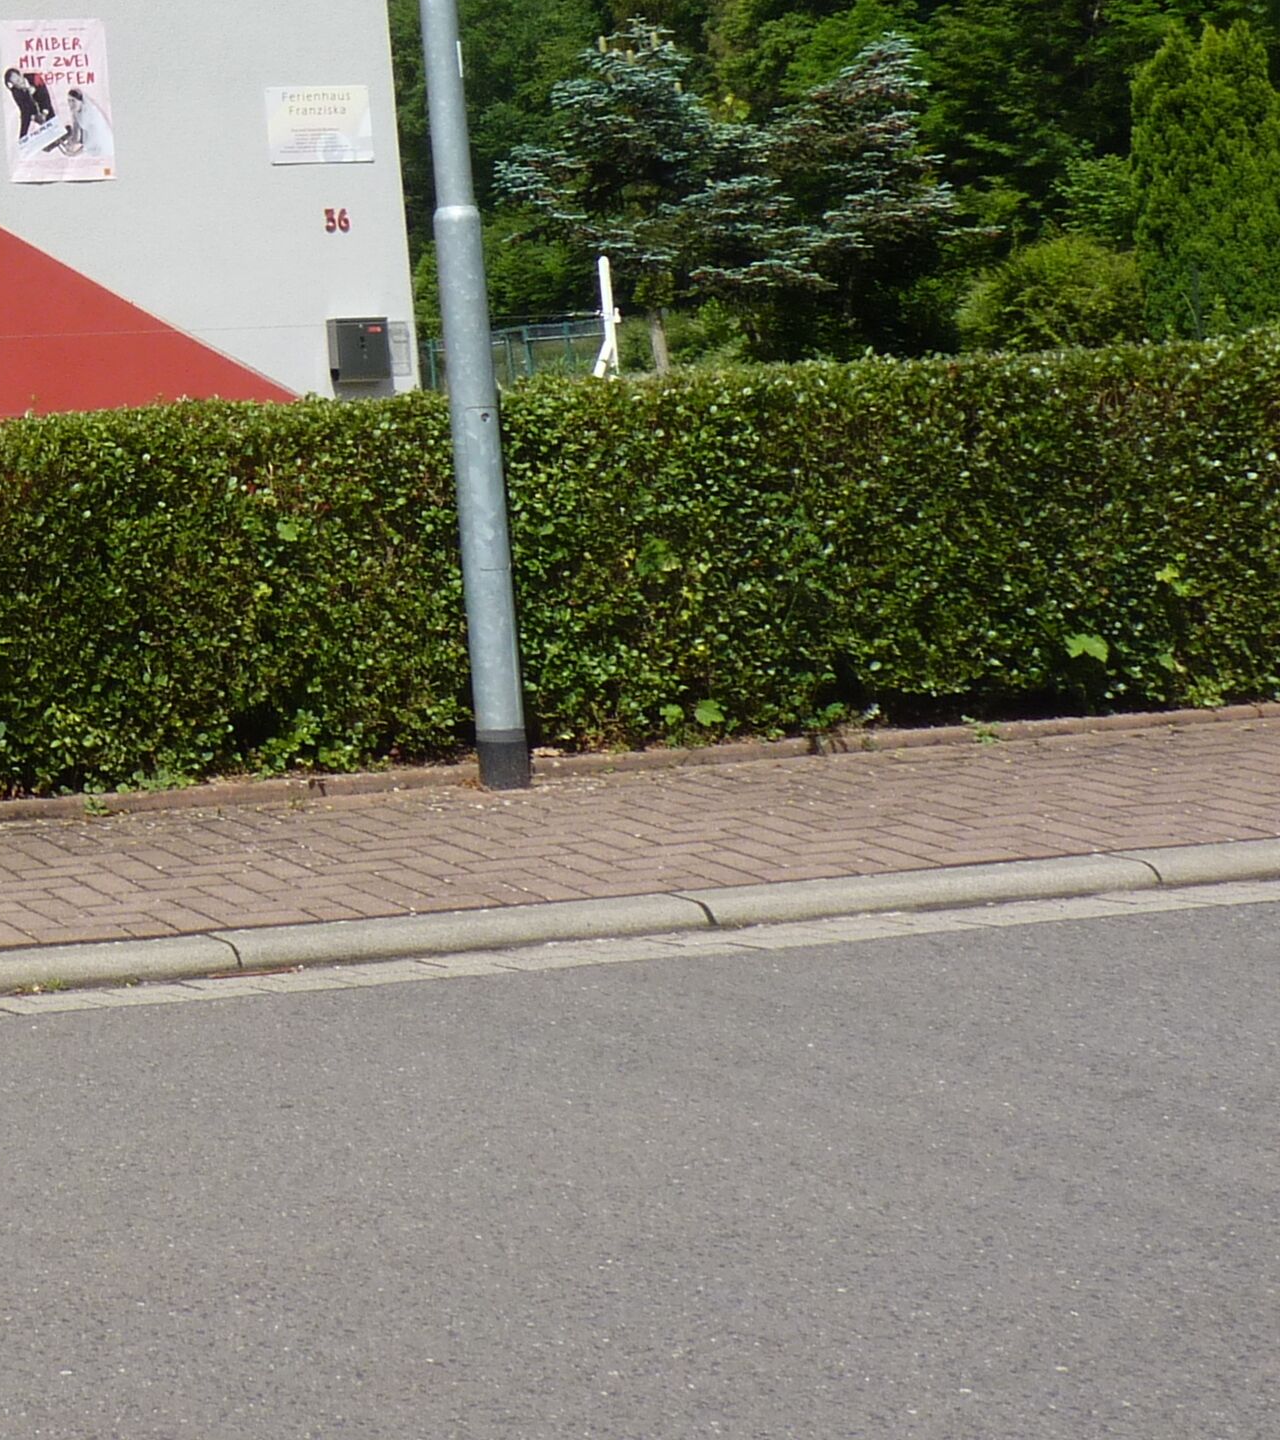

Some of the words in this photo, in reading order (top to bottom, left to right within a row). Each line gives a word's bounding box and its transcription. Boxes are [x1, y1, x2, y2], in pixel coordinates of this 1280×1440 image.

[19, 55, 45, 68] MIT
[53, 54, 89, 67] ZWEI
[281, 91, 351, 102] Ferienhaus
[288, 105, 347, 115] Franziska
[324, 208, 350, 233] 36
